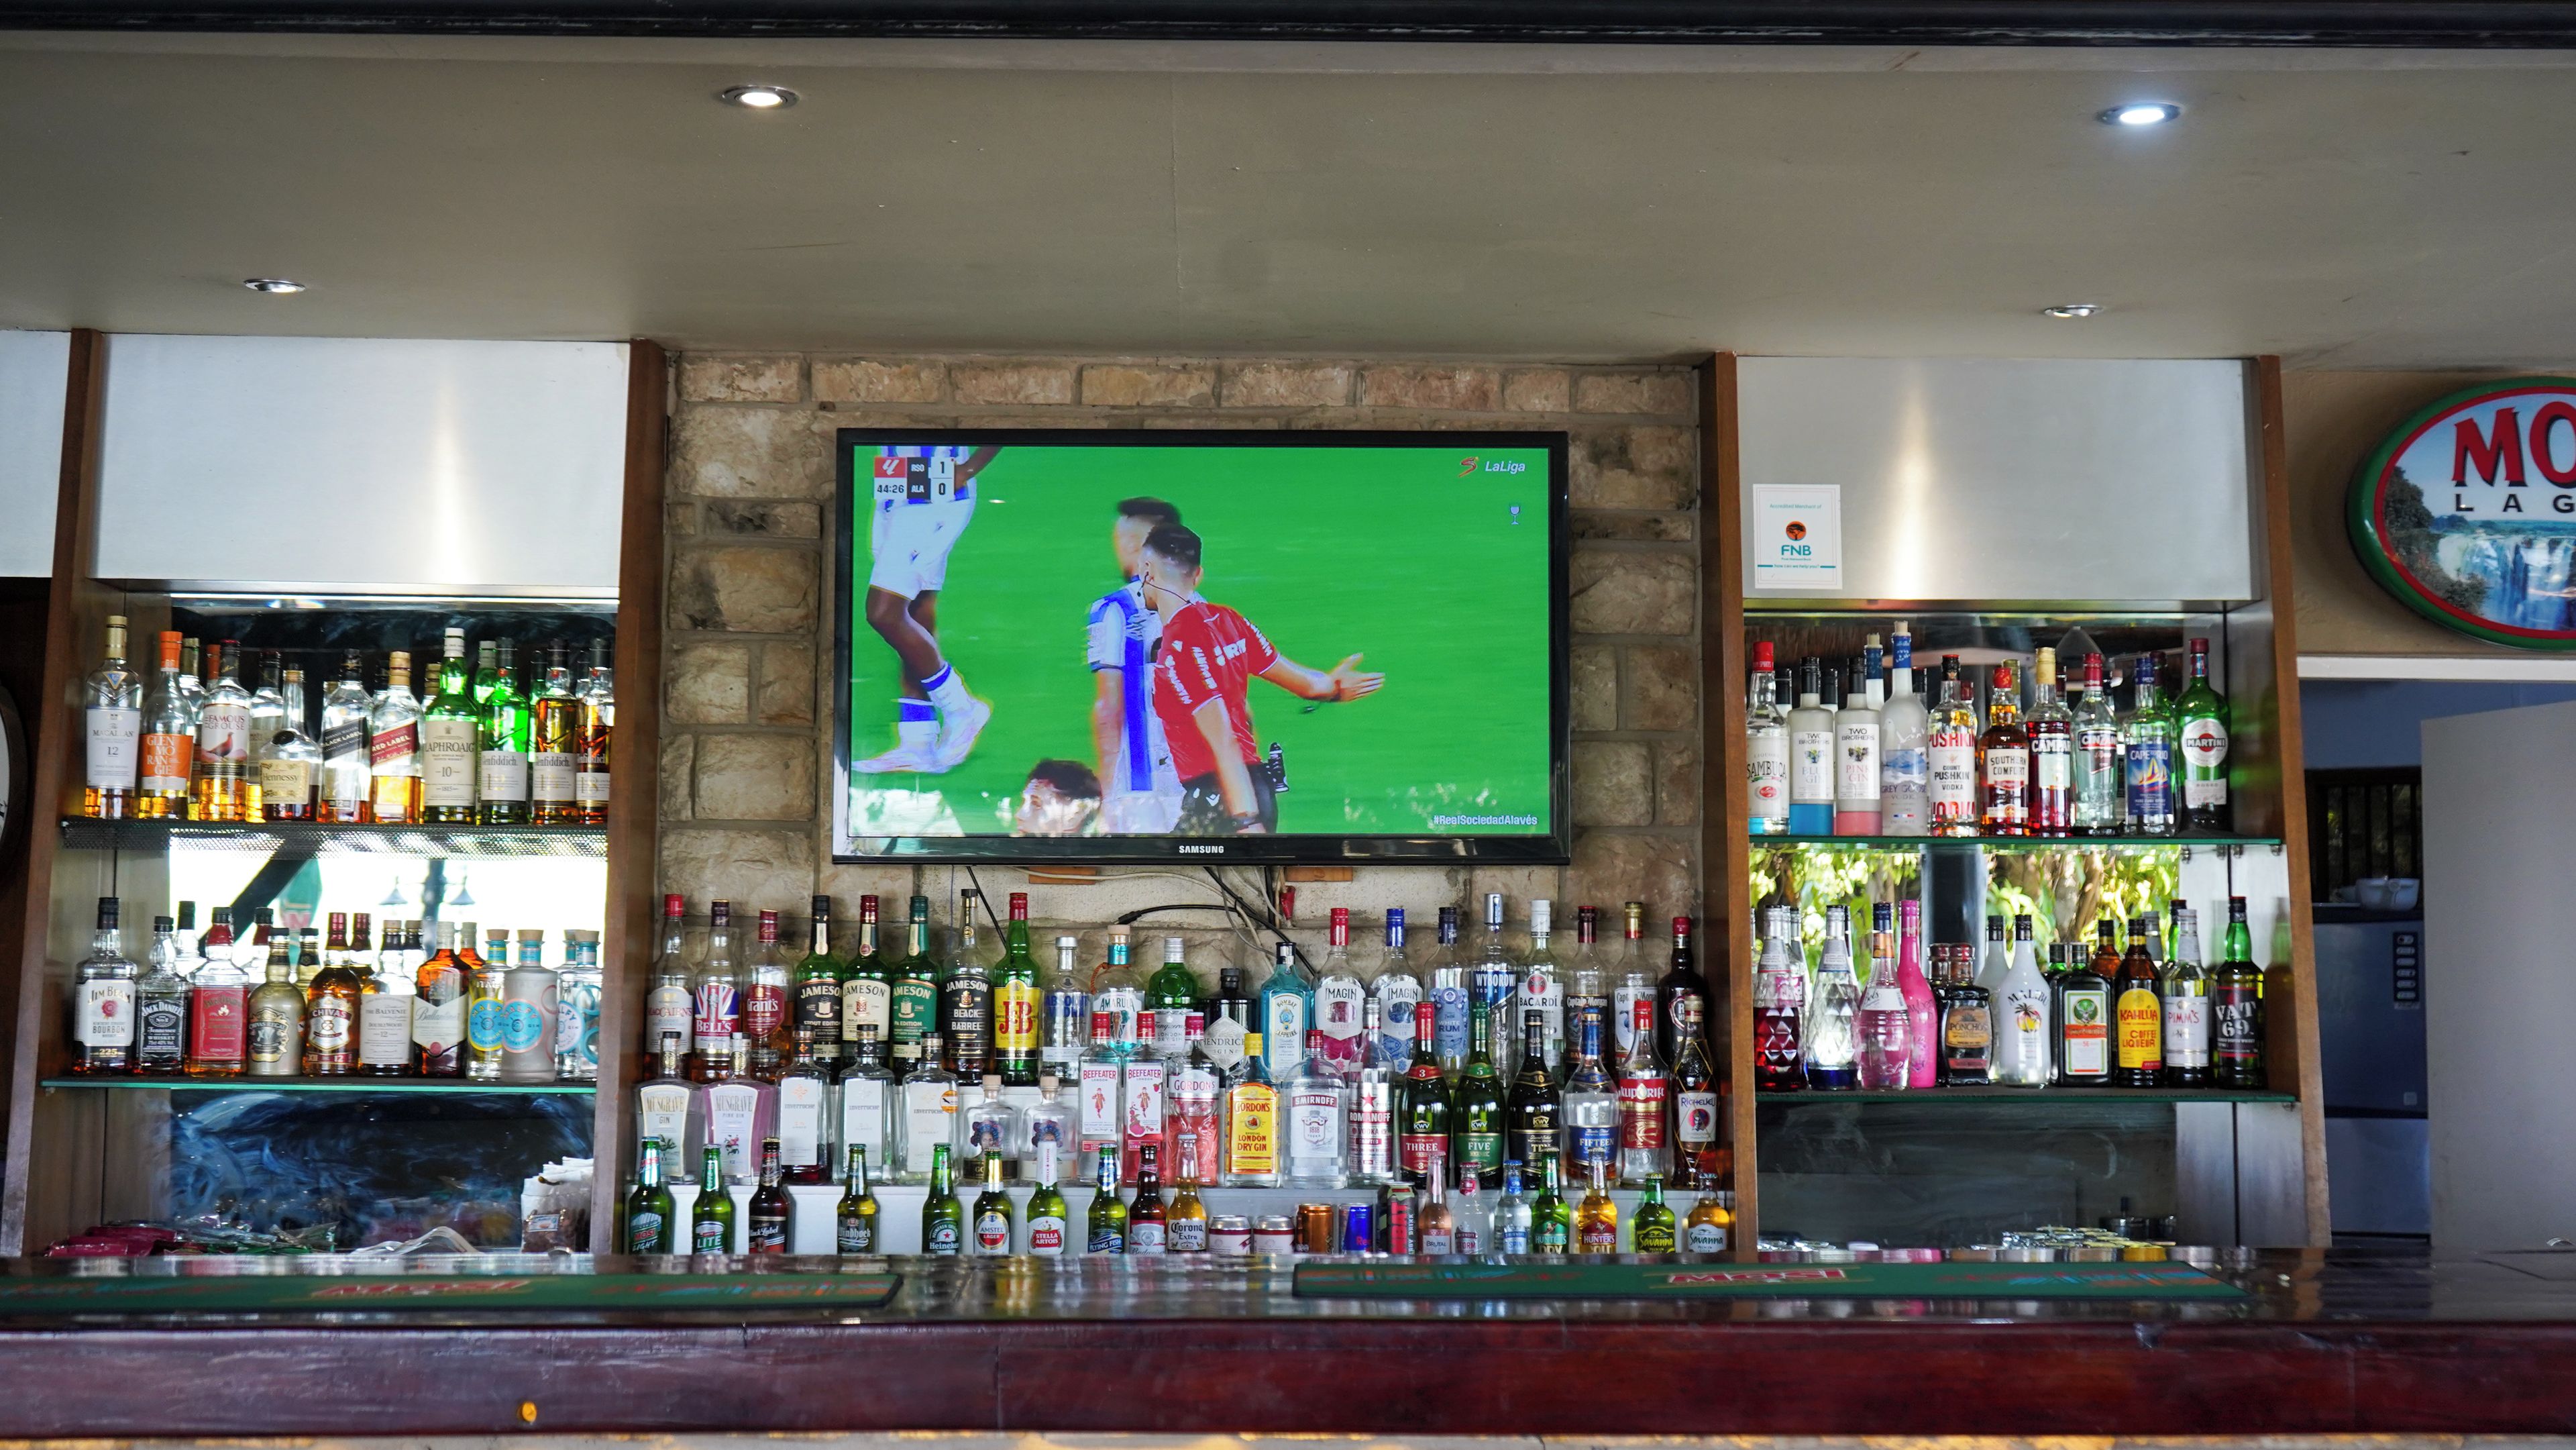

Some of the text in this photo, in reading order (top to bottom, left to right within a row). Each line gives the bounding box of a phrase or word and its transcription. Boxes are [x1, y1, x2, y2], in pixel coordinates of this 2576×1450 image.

[911, 462, 945, 474] RSO 1
[1485, 461, 1525, 474] LaLiga
[877, 484, 904, 493] 44:26
[938, 483, 945, 495] 0
[1781, 545, 1811, 556] FNB
[209, 715, 245, 723] FAMOUS
[147, 735, 174, 745] GLEN
[321, 731, 363, 747] BLACK LABEL
[372, 735, 411, 752] RED LABEL
[2186, 739, 2226, 747] MARTINI
[107, 747, 119, 756] 12
[156, 745, 176, 756] MO
[425, 741, 475, 753] LAPHROAIG
[147, 756, 168, 765] RAN
[2130, 749, 2169, 761] CAPE RIO
[154, 766, 172, 775] GIE
[441, 766, 452, 777] 10
[1746, 760, 1787, 779] SAMBUCA
[262, 773, 299, 782] Hennessy
[1934, 772, 1970, 781] PUSHKIN
[1881, 785, 1897, 794] GREY
[1434, 815, 1538, 825] #RealSociedadAlavés
[1179, 845, 1224, 853] SAMSUNG
[843, 984, 886, 998] JAMESON
[945, 980, 989, 993] JAMESON
[89, 986, 131, 1004] JIM BEAM
[893, 985, 933, 1000] AMESON
[1325, 988, 1357, 1001] IMAGIN
[1387, 988, 1419, 1001] IMAGIN
[2007, 988, 2049, 1006] MALIBU
[747, 998, 779, 1012] Grant's
[1100, 998, 1136, 1013] AMARULA
[1519, 995, 1558, 1006] BACARDÍ
[1587, 996, 1608, 1007] Morgan
[142, 1004, 159, 1017] JACK
[311, 1008, 347, 1018] CHIVAS
[953, 1008, 979, 1018] BLACK
[2215, 1001, 2257, 1021] VAT
[2168, 1009, 2200, 1024] PIMM'S
[93, 1026, 125, 1034] BOURBON
[696, 1019, 733, 1032] BELL'S
[951, 1022, 981, 1031] BARREL
[2222, 1020, 2250, 1037] 69
[2130, 1030, 2157, 1039] COFFEE
[2122, 1039, 2156, 1048] LIQUEUR
[333, 1054, 343, 1062] 12
[1083, 1070, 1117, 1080] BEEFEATER
[1128, 1068, 1162, 1079] BEEFEATER
[1419, 1069, 1426, 1078] 3
[1477, 1068, 1483, 1076] 5
[646, 1096, 684, 1112] MUSGRAVE
[715, 1095, 753, 1112] MUSGRAVE
[1295, 1096, 1335, 1106] SMIRNOFF
[1234, 1102, 1271, 1112] GORDON'S
[659, 1116, 670, 1124] GIN
[1349, 1112, 1391, 1122] ROMANOFF
[1532, 1117, 1550, 1127] KWV
[1309, 1126, 1320, 1134] 1818
[1413, 1122, 1431, 1130] KWV
[1470, 1121, 1488, 1129] KWV
[1237, 1143, 1267, 1151] DRY GIN
[1405, 1142, 1438, 1152] THREE
[1467, 1142, 1491, 1151] FIVE
[1579, 1137, 1615, 1147] FIFTEEN
[1417, 1162, 1424, 1170] 3
[761, 1225, 779, 1237] Label
[1171, 1222, 1203, 1235] Corona
[697, 1235, 722, 1249] LITE
[1178, 1233, 1198, 1241] Extra
[1584, 1235, 1615, 1244] HUNTER'S
[1639, 1235, 1674, 1248] Savanna
[1689, 1233, 1724, 1246] Savanna
[632, 1239, 658, 1252] LIGHT
[1089, 1238, 1122, 1251] FLYING FISH
